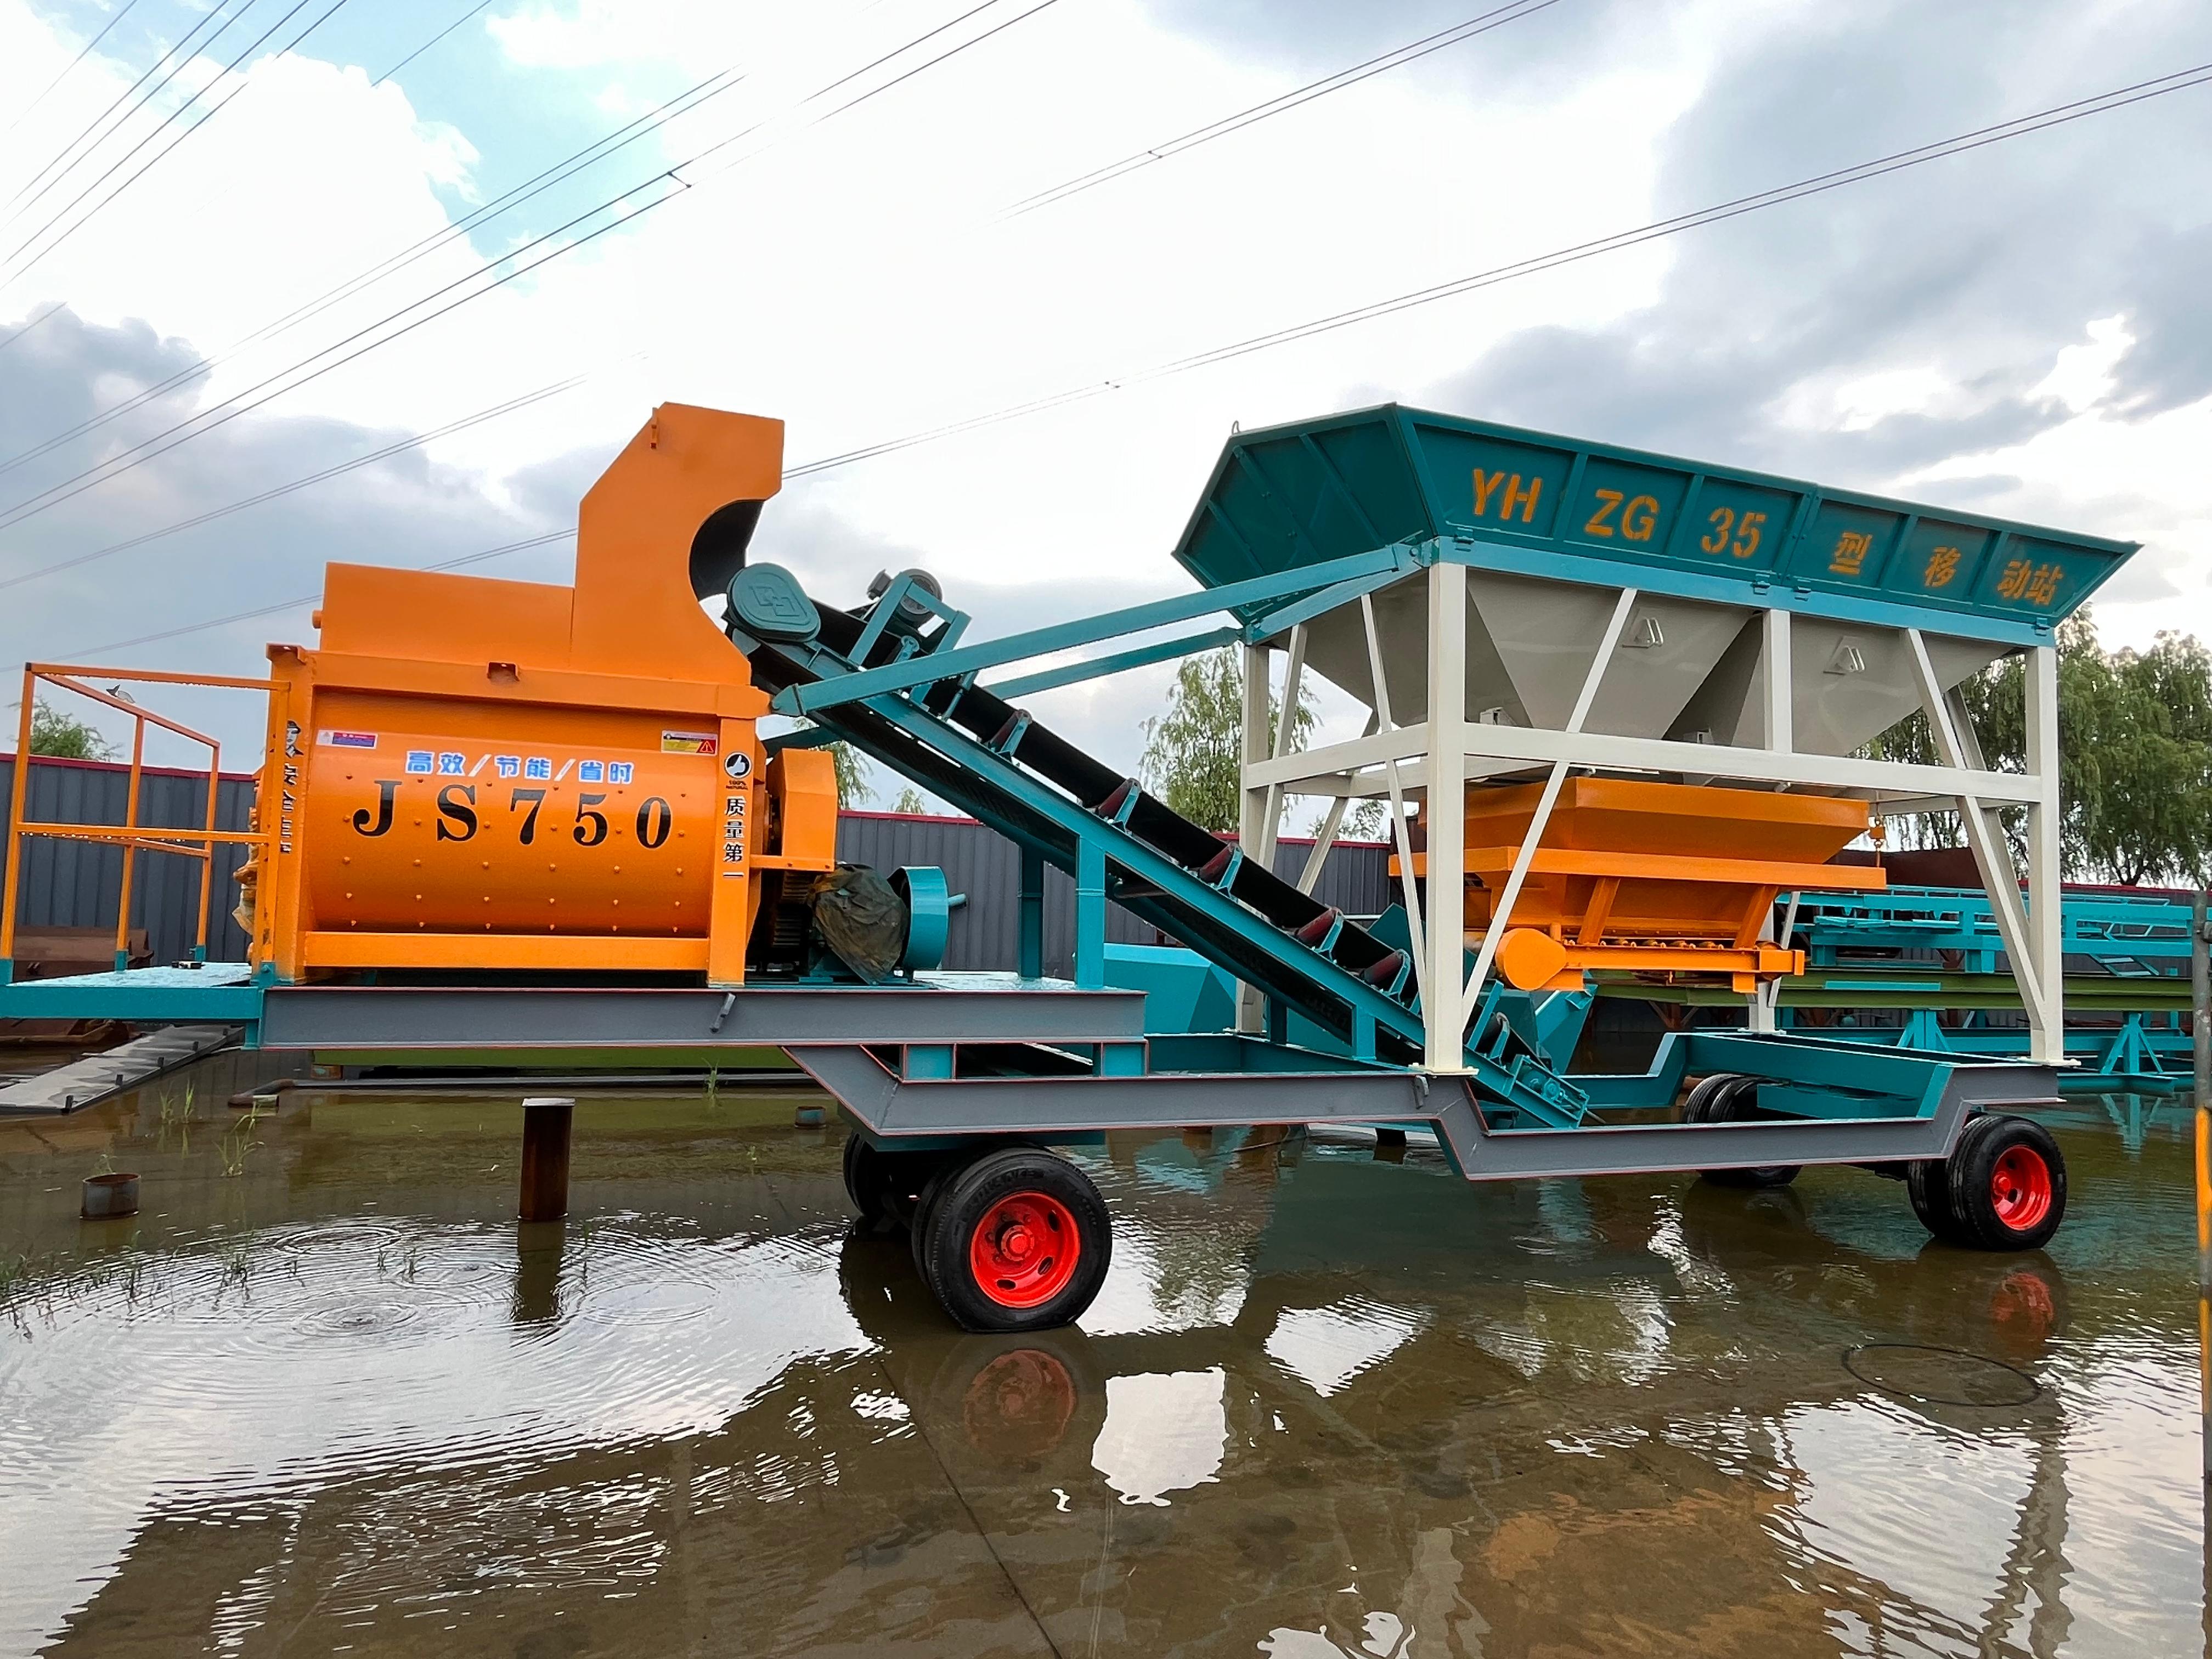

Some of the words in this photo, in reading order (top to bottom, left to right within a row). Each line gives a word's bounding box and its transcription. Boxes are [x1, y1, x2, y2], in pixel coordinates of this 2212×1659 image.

[1473, 468, 1542, 522] YH
[1584, 488, 1660, 541] ZG
[1702, 507, 1766, 558] 35
[1829, 532, 2063, 605] 型移动站
[352, 780, 672, 849] JS750
[723, 795, 746, 878] 质量第一
